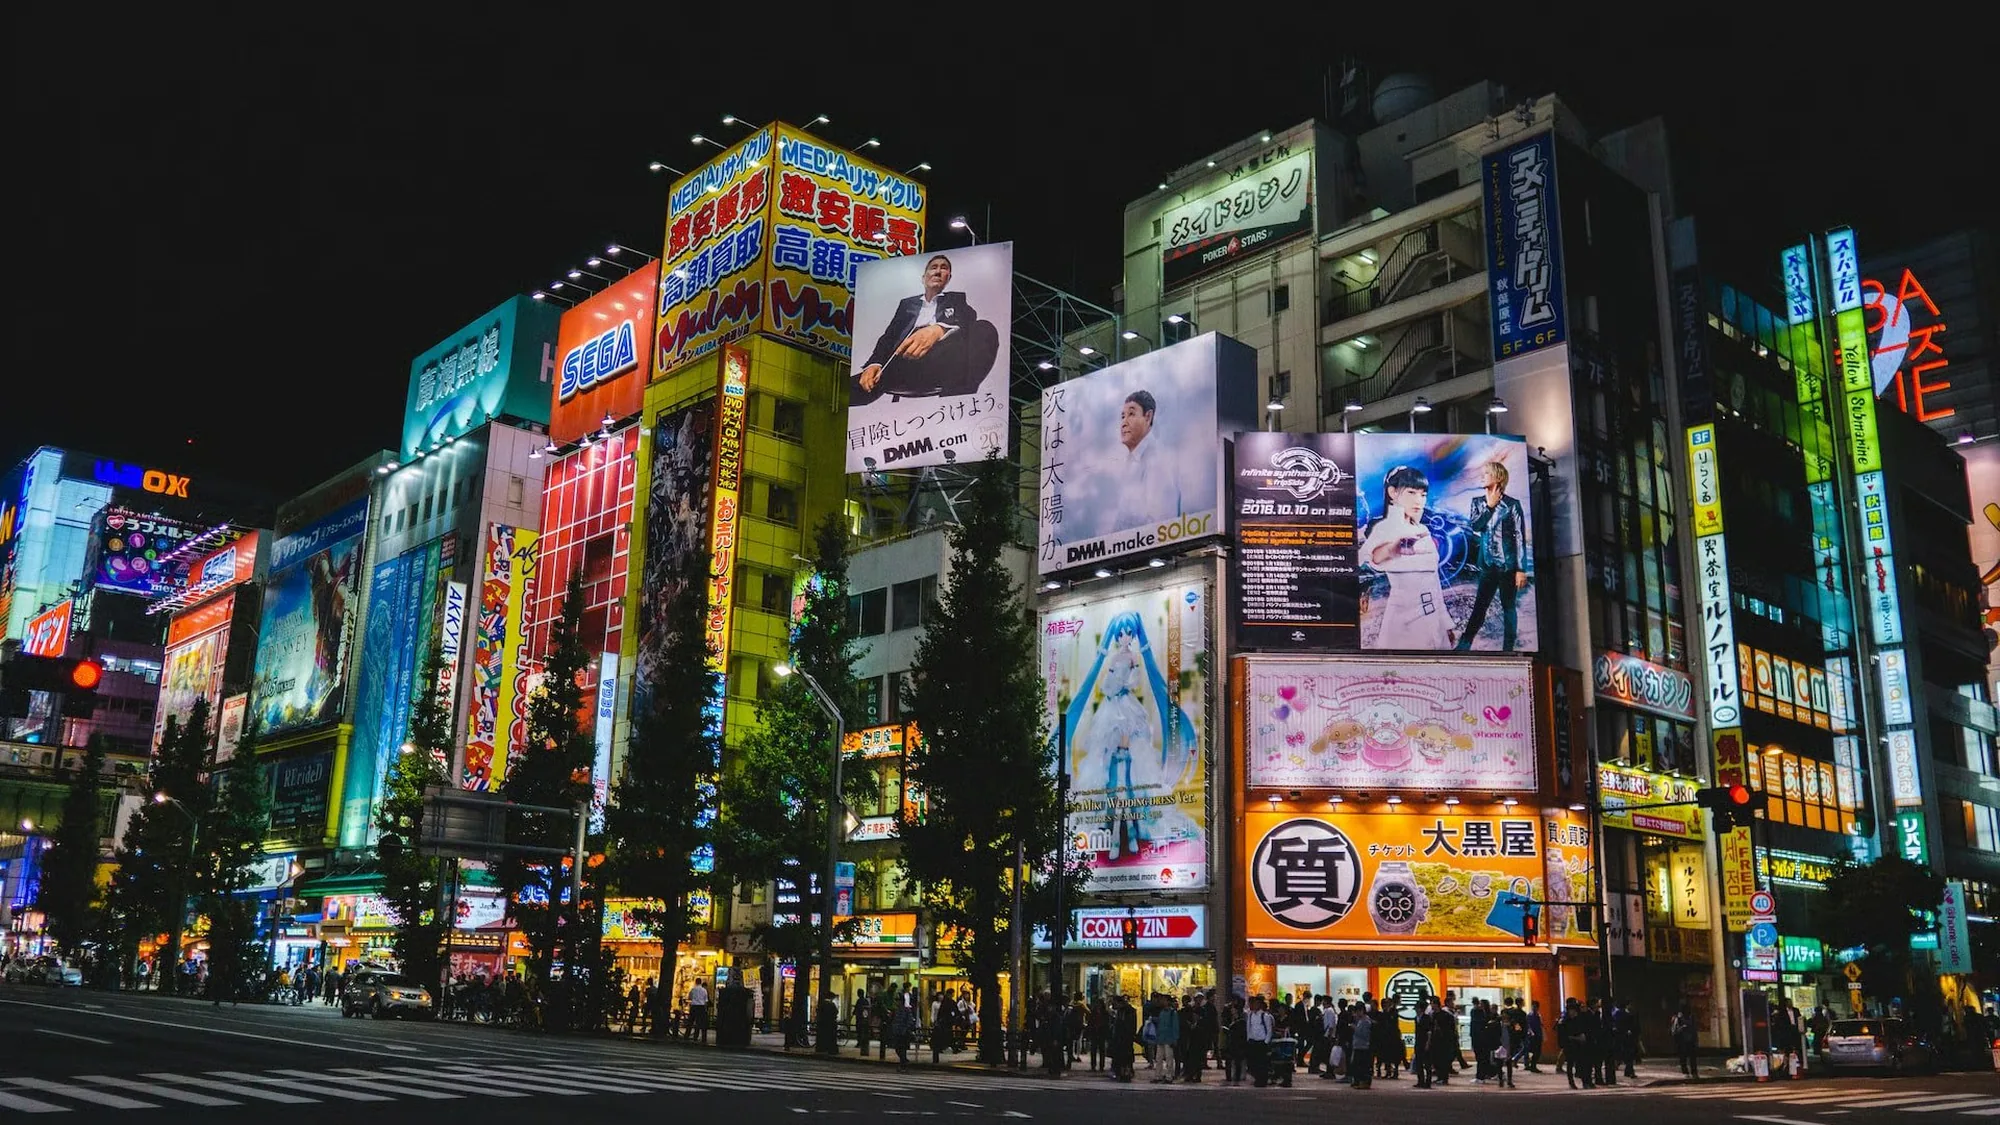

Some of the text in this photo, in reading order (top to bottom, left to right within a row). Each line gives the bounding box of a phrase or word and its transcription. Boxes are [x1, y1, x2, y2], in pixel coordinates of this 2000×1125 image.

[668, 169, 768, 260] 激安販売
[780, 172, 919, 256] 激安販売
[1171, 168, 1302, 247] メイドカジノ
[1202, 229, 1268, 264] POKER STARS
[662, 219, 762, 315] 高額買取
[1496, 277, 1512, 336] 秋葉原店
[559, 319, 638, 403] SEGA
[1842, 344, 1859, 386] Yellow
[725, 396, 742, 409] DVD
[848, 392, 1004, 450] 冒険しつづけよう。
[723, 417, 741, 430] ゲーム
[725, 428, 738, 438] CD
[1693, 430, 1711, 446] 3F
[1850, 396, 1869, 466] Submarine
[720, 447, 739, 459] アニメ
[883, 433, 968, 464] DMM.com
[1041, 386, 1066, 570] 次は太陽か。
[1698, 451, 1712, 503] りらくる
[1862, 473, 1877, 484] 5F
[1241, 503, 1353, 516] 2018.10.10 on sale
[1067, 512, 1212, 564] DMM.make solar
[444, 586, 463, 640] AKKY
[1046, 619, 1085, 637] 初音ミク
[1704, 538, 1735, 702] 喫茶室ルノアール
[600, 678, 615, 719] SEGA
[1594, 654, 1693, 712] メイドカジノ
[1505, 731, 1524, 740] cafe
[1176, 792, 1197, 805] Ver.
[1369, 819, 1537, 858] チケット 大黒屋
[1128, 872, 1141, 882] and
[1141, 871, 1157, 881] more
[1263, 836, 1352, 917] 質
[1683, 866, 1698, 918] ルノアール
[1755, 897, 1769, 910] 40
[1082, 938, 1124, 949] Akihabar
[1083, 917, 1168, 938] COM ZIN
[1785, 944, 1822, 964] リバティー
